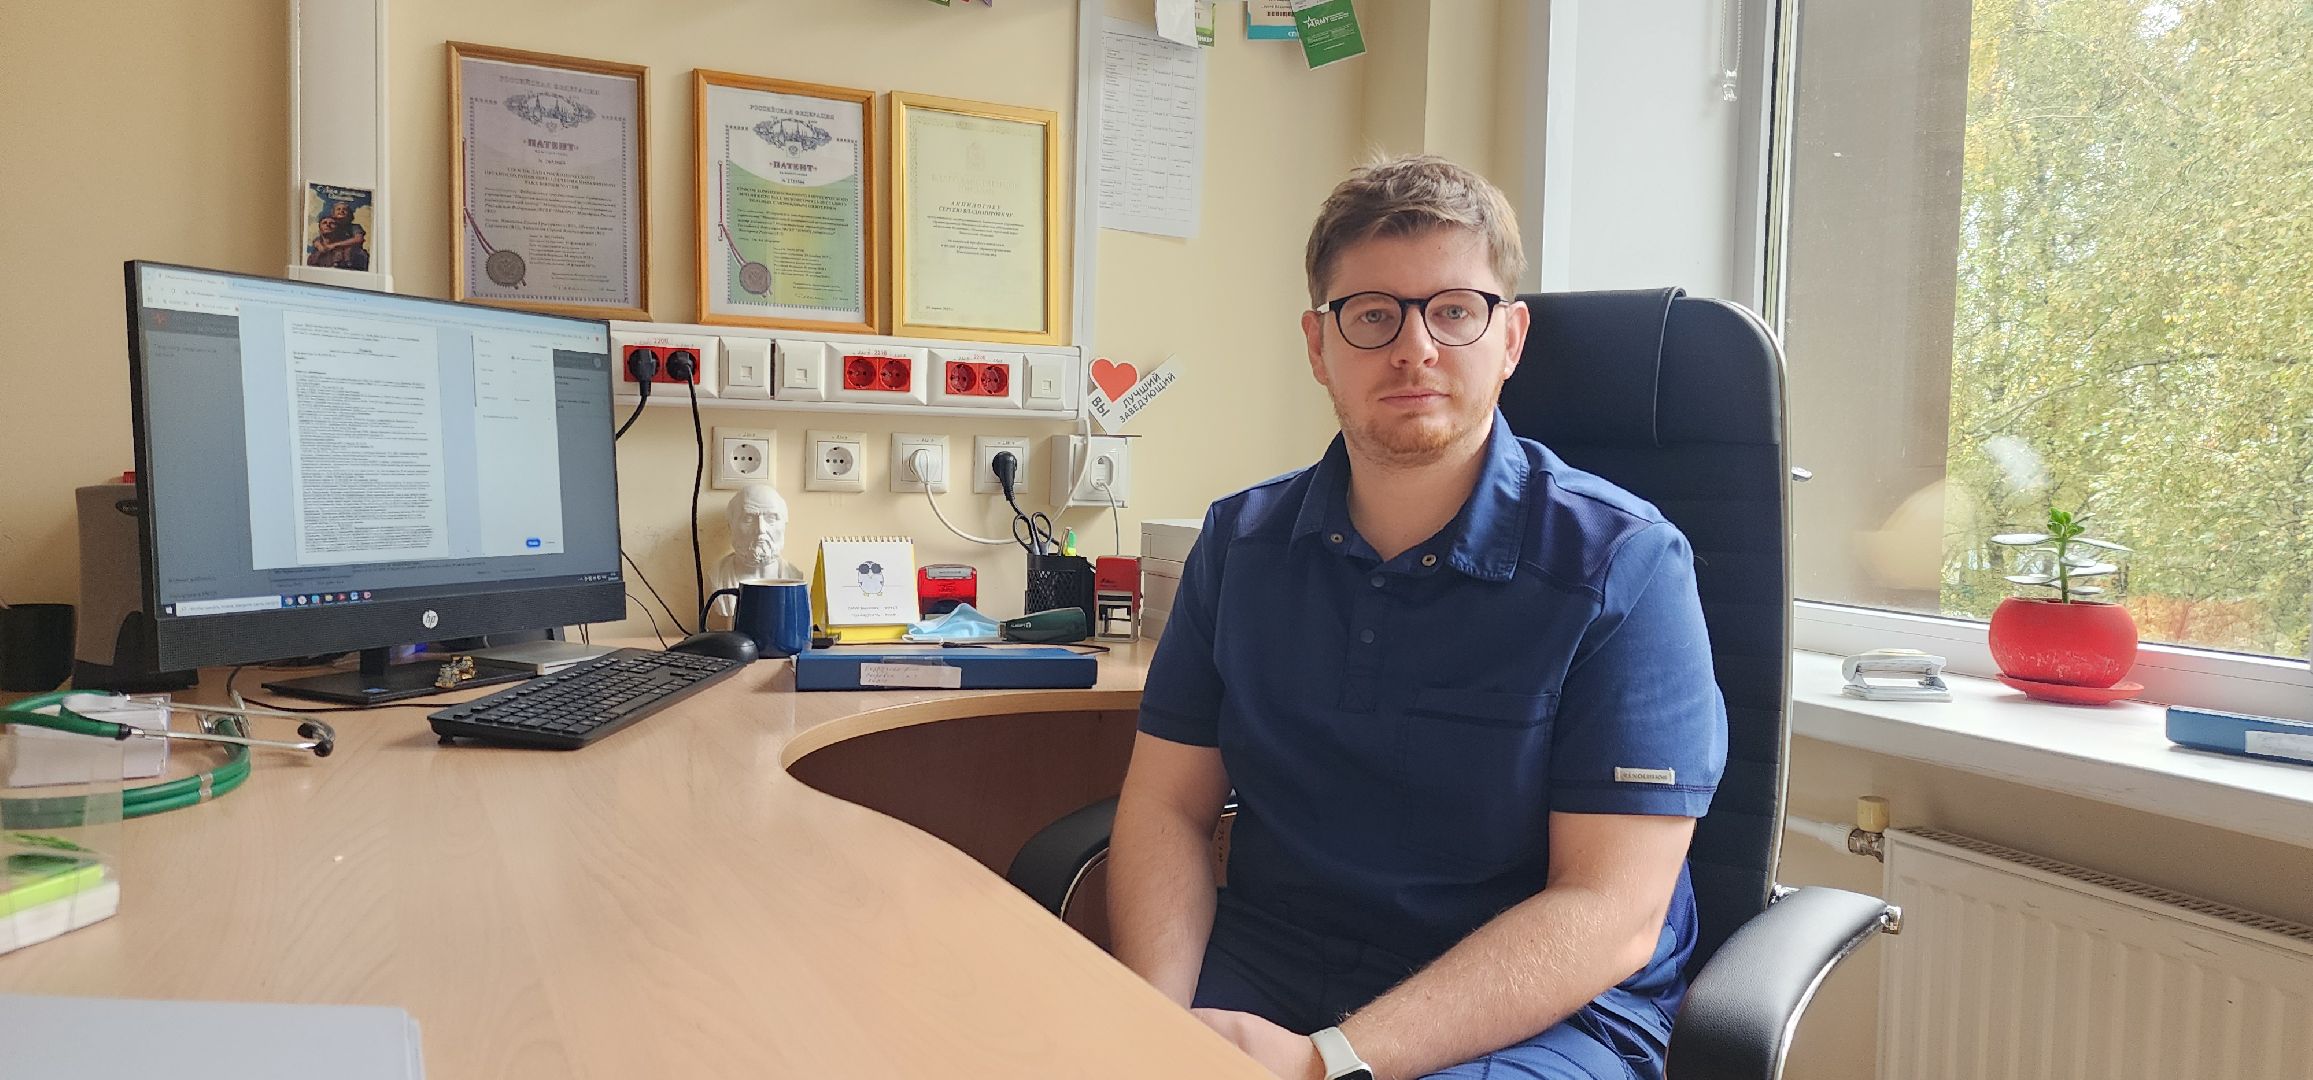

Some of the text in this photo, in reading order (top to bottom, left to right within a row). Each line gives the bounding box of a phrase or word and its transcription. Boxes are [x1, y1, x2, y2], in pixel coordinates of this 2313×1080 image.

[528, 138, 575, 151] ПАТЕНТ
[773, 160, 814, 172] ПАТЕНТ
[1119, 371, 1176, 424] ЗАВЕДУЮЩИЙ
[1122, 371, 1162, 409] ЛУЧШИЙ
[1091, 396, 1111, 417] ВЫ
